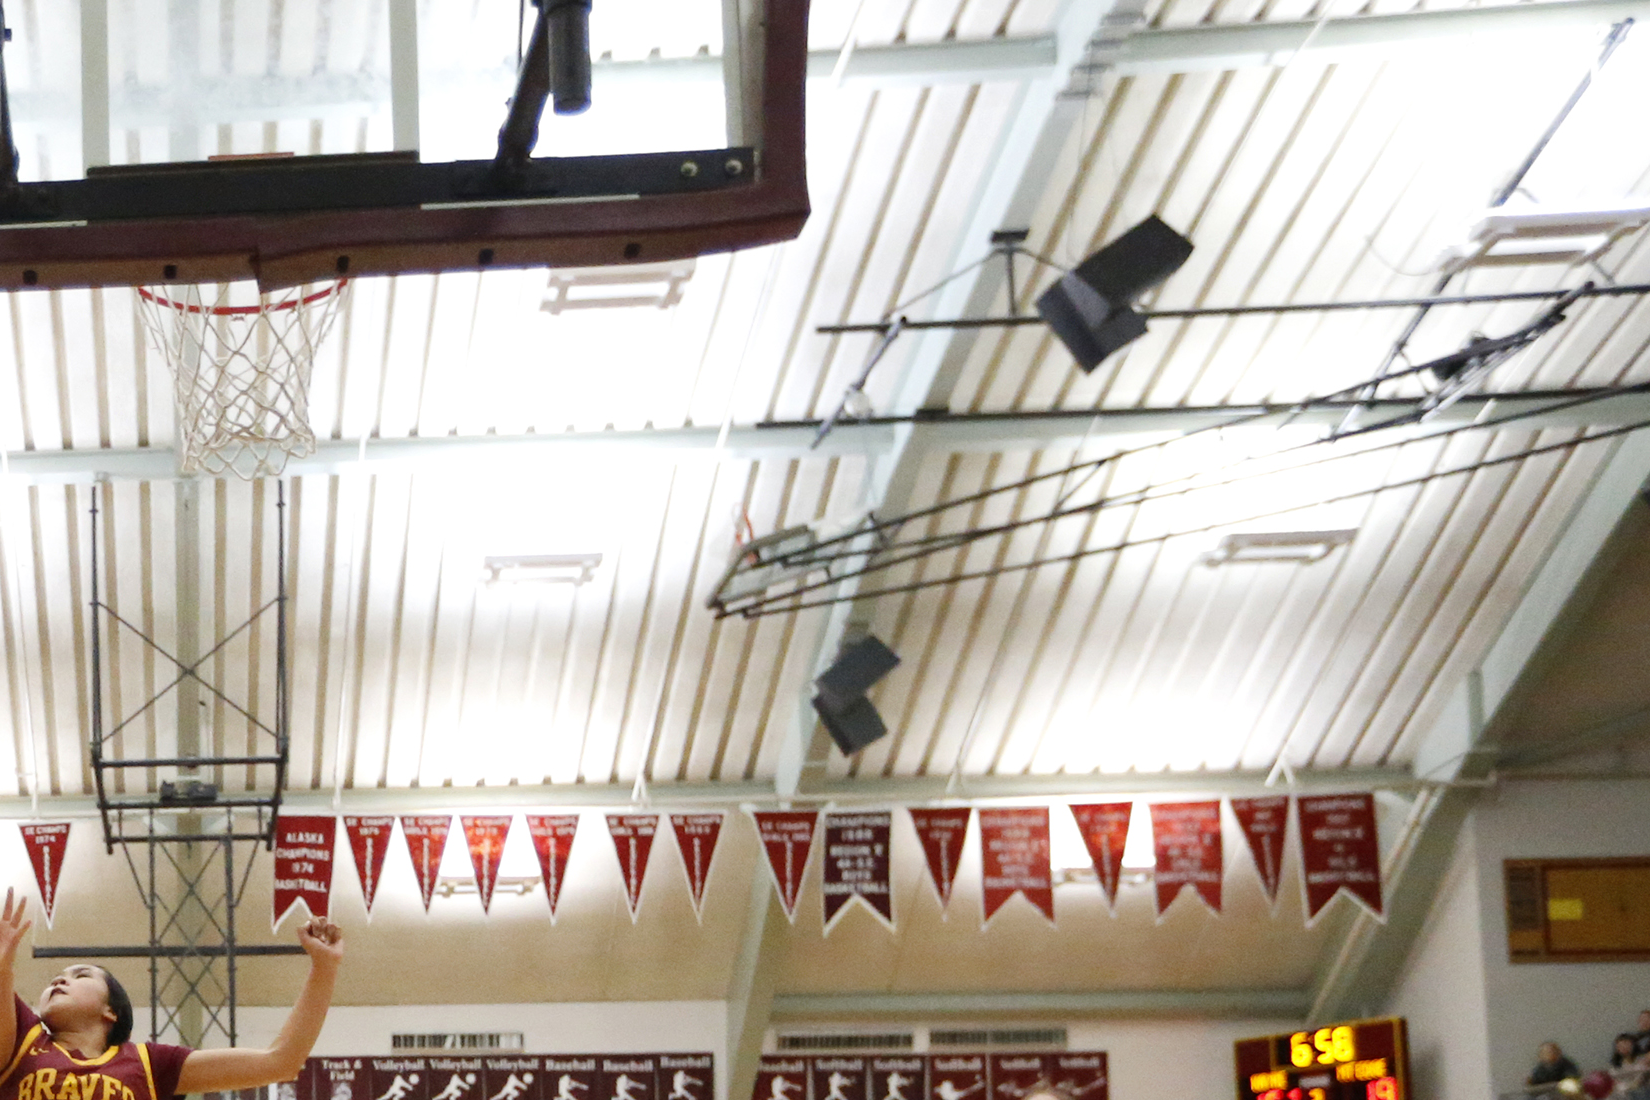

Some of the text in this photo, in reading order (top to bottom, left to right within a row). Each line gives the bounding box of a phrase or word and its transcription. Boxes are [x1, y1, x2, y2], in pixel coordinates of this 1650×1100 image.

[36, 825, 67, 834] CHAMPS
[286, 833, 324, 843] ALASKA
[276, 848, 329, 861] CHAMPIONS
[274, 879, 327, 893] BASKETBALL
[1290, 1026, 1355, 1067] 6:58
[322, 1059, 350, 1070] Track
[372, 1060, 425, 1071] Volleyball
[430, 1059, 482, 1071] Volleyball
[487, 1059, 539, 1071] Volleyball
[545, 1059, 596, 1071] Baseball
[603, 1060, 654, 1072] Baseball
[660, 1056, 711, 1068] Baseball
[330, 1071, 355, 1081] Field
